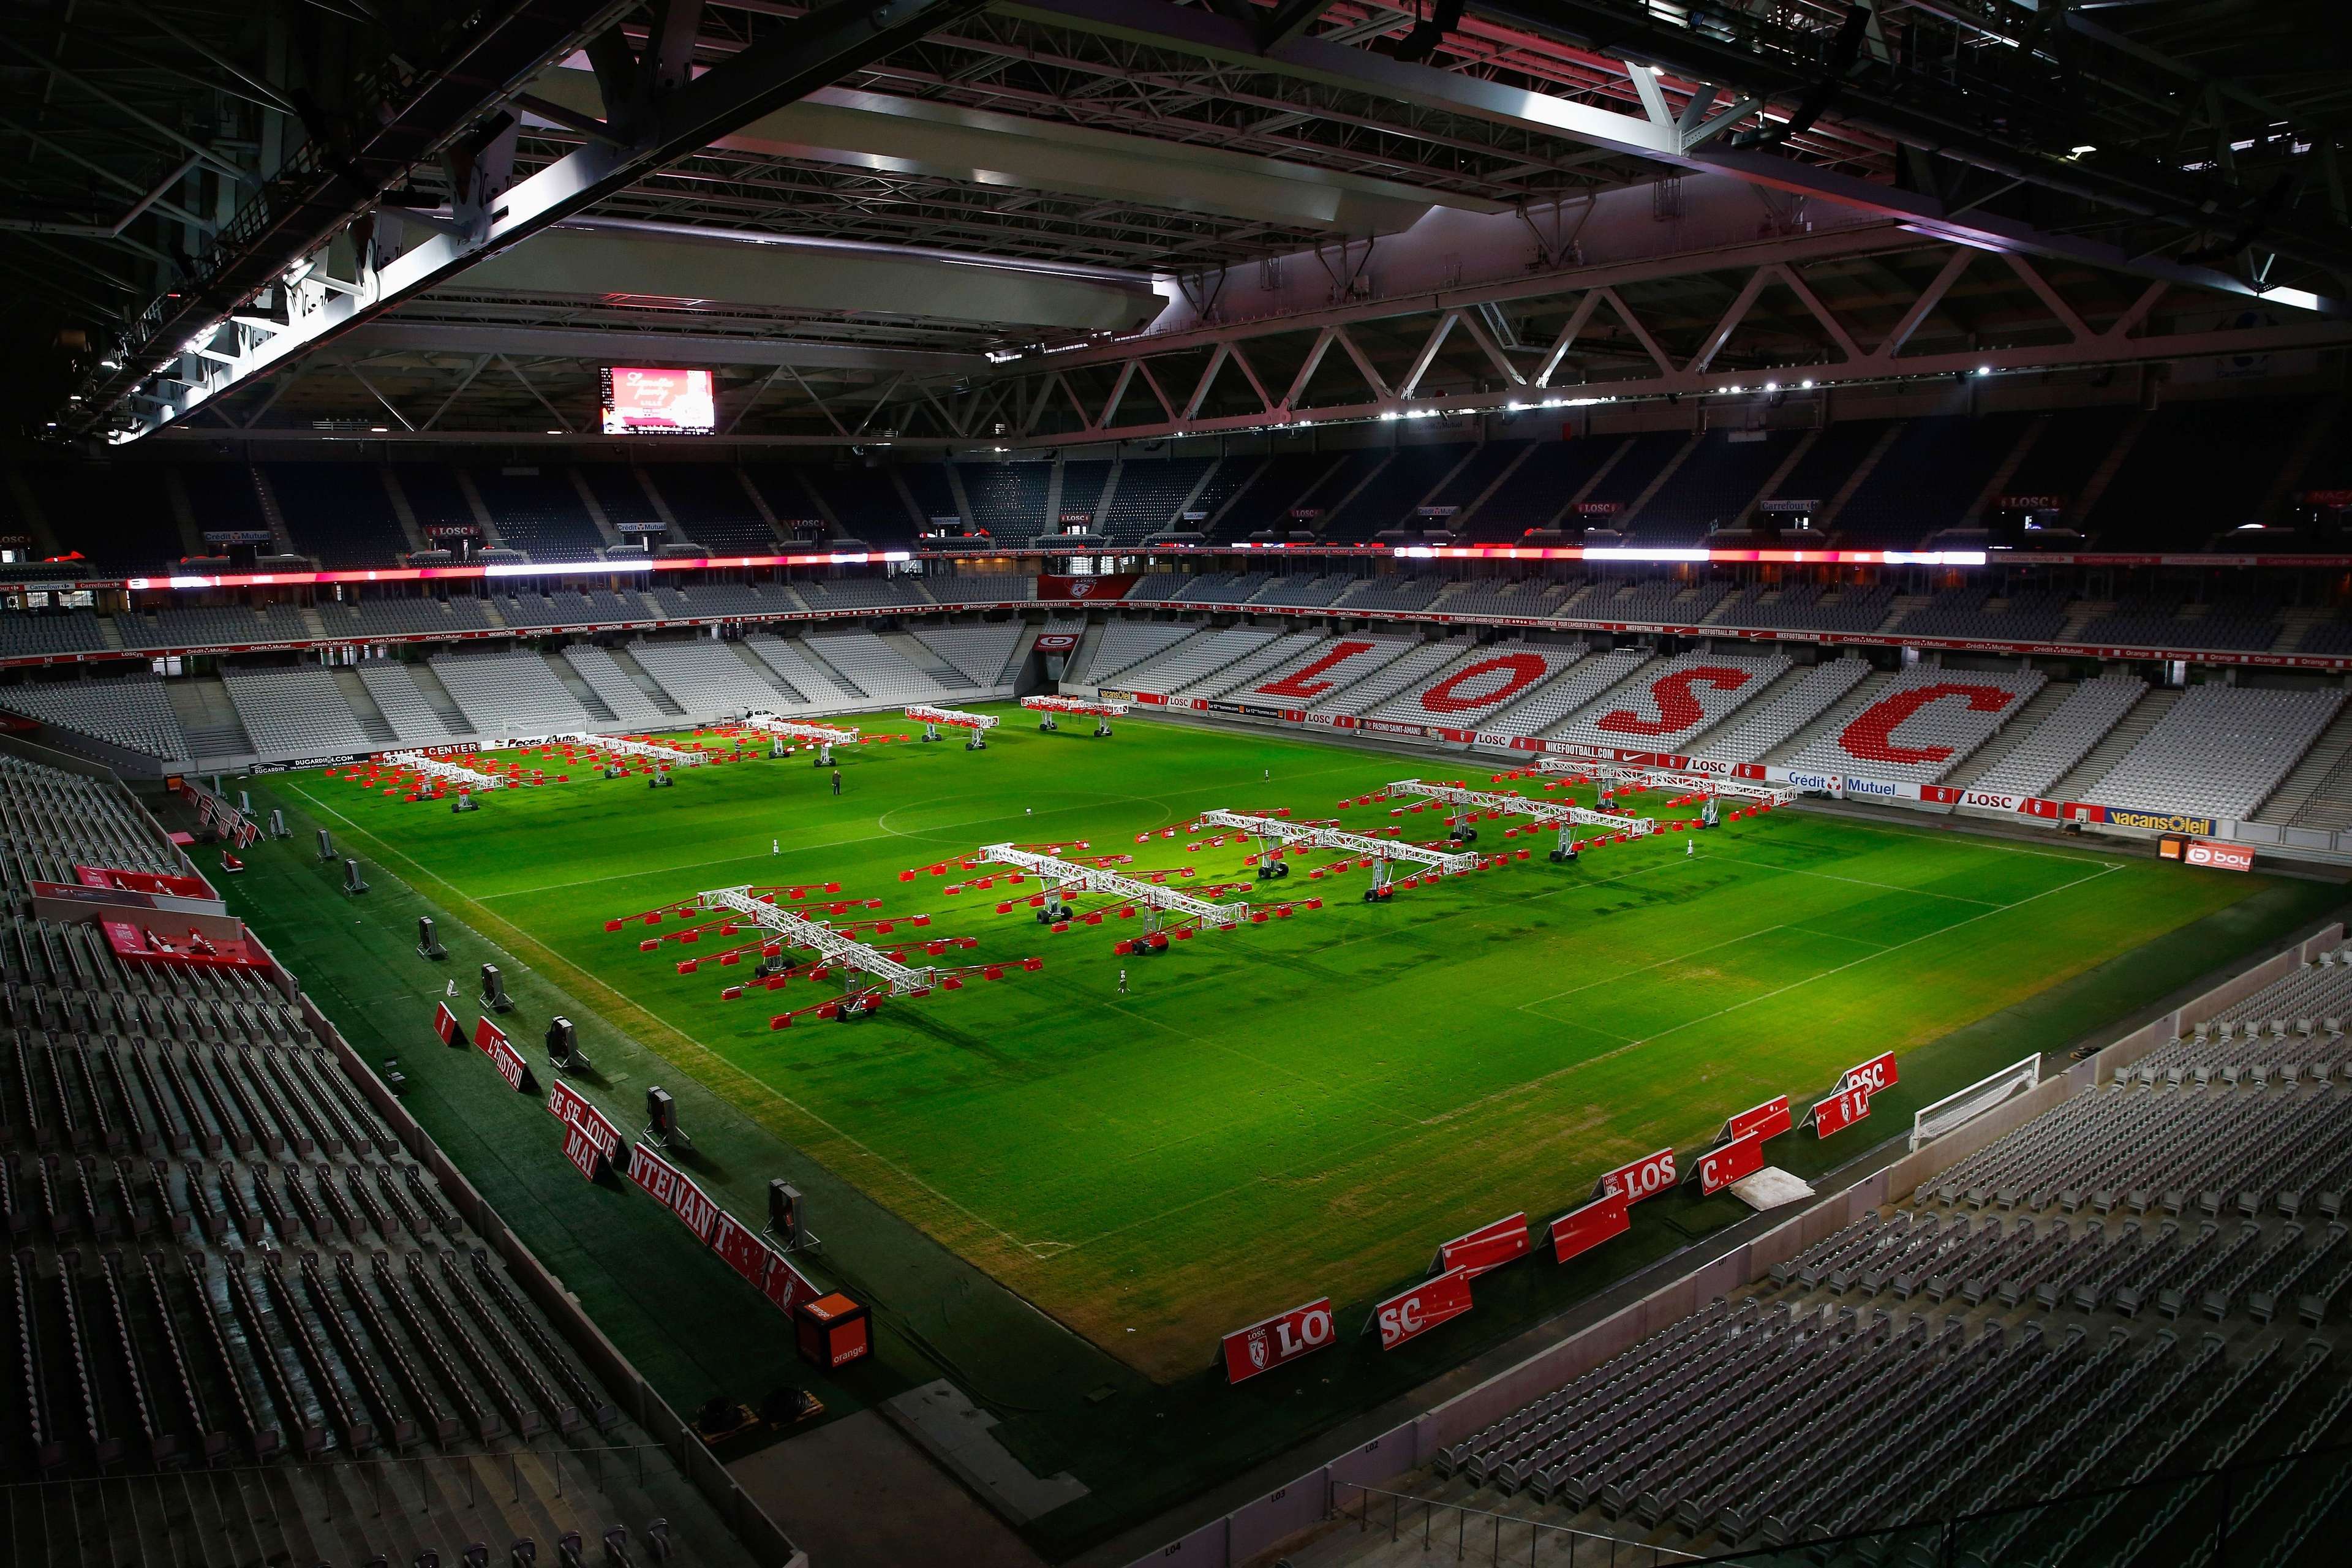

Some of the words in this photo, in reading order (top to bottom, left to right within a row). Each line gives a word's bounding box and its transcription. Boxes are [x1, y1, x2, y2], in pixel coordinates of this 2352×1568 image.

[1585, 504, 1609, 513] LOSC
[1763, 502, 1804, 510] Carrefour
[2011, 497, 2048, 507] LOSC
[1698, 627, 1739, 636] NIKEFOOTBALL.COM
[1776, 633, 1820, 642] NIKEFOOTBALL.COM
[1170, 698, 1188, 707] LOSC
[1308, 714, 1330, 723] LOSC
[1372, 722, 1389, 732] PASINO
[1389, 723, 1421, 735] SAINT-AMAND
[1479, 734, 1506, 745] LOSC
[429, 743, 478, 756] CENTER
[1545, 741, 1615, 760] NIKEFOOTBALL.COM
[1692, 760, 1727, 774] LOSC
[1789, 771, 1826, 789] Crédit
[1848, 778, 1896, 796] Mutuel
[1967, 793, 2012, 809] LOSC
[2214, 850, 2252, 866] bou
[1605, 1175, 1618, 1185] LOSC
[1624, 1155, 1676, 1200] LOS
[1703, 1159, 1719, 1188] C
[809, 1303, 830, 1318] orange
[1379, 1297, 1423, 1346] SC
[1248, 1329, 1265, 1341] LOSC
[1276, 1310, 1330, 1357] LO
[834, 1345, 864, 1363] orange
[1366, 1440, 1378, 1453] L02
[1272, 1489, 1285, 1502] L03
[1166, 1542, 1181, 1556] L04
